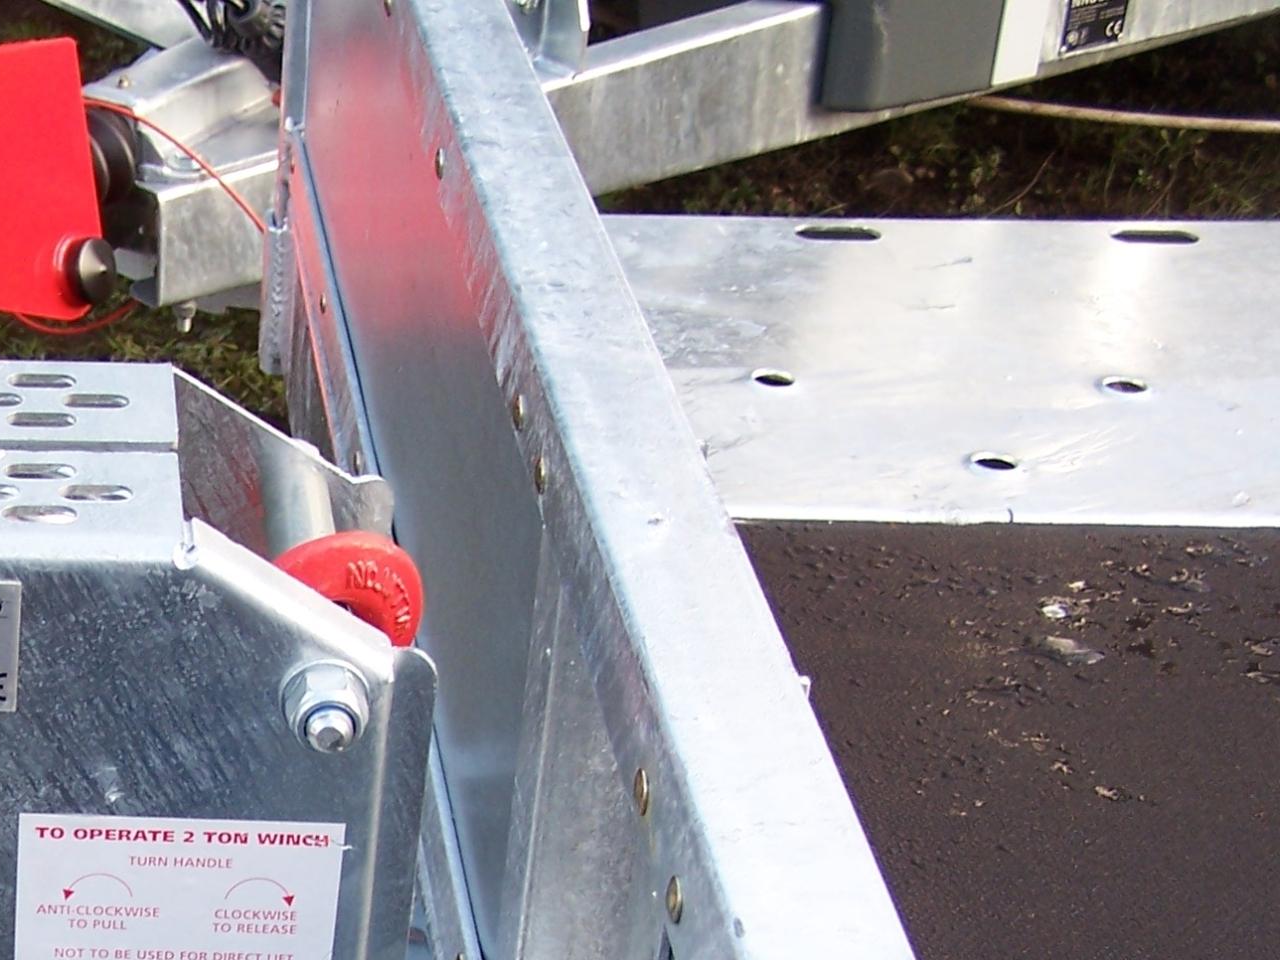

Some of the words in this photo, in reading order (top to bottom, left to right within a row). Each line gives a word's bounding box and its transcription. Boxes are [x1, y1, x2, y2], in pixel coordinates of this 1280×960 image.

[35, 826, 65, 840] TO
[73, 827, 175, 843] OPERATE
[183, 831, 196, 844] 2
[203, 831, 249, 845] TON
[257, 832, 330, 848] WINCH
[128, 855, 169, 868] TURN
[173, 856, 233, 870] HANDLE
[36, 903, 160, 918] ANTI-CLOCKWISE
[214, 908, 298, 922] CLOCKWISE
[68, 918, 90, 930] TO
[92, 918, 127, 931] PULL
[212, 922, 233, 934] TO
[236, 922, 298, 935] RELEASE
[53, 947, 86, 960] NOT
[90, 948, 110, 960] TO
[114, 948, 132, 960] BE
